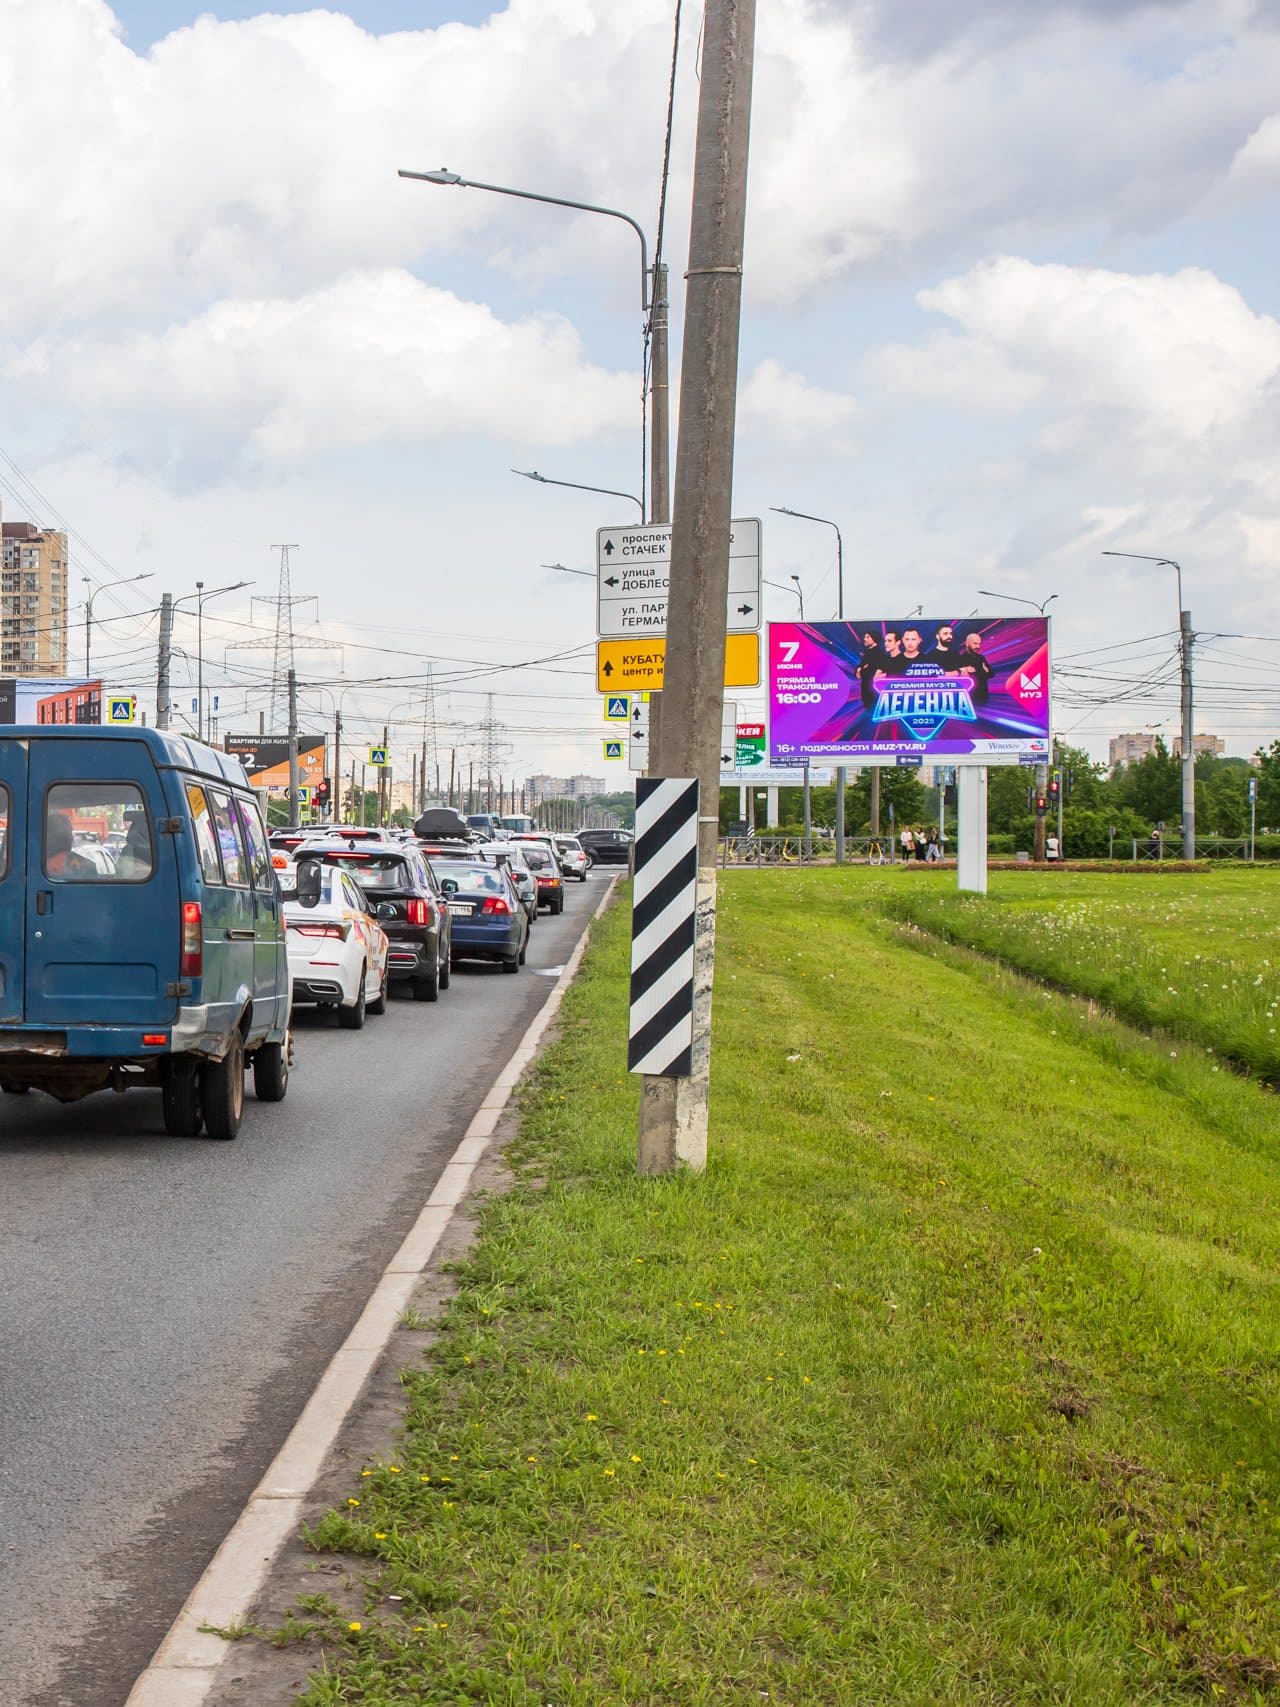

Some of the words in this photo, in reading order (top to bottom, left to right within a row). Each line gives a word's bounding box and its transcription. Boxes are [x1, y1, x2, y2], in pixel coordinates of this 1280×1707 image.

[622, 533, 672, 544] проспект
[622, 544, 666, 556] СТАЧЕК
[622, 569, 656, 579] улица
[622, 607, 638, 616] ул.
[779, 642, 800, 662] 7
[622, 667, 654, 677] центр
[905, 668, 944, 676] ЗВЕРИ
[776, 676, 815, 684] ПРЯМАЯ
[776, 683, 839, 691] ТРАНСЛЯЦИЯ
[776, 692, 822, 704] 16:00
[877, 691, 972, 717] ЛЕГЕНДА
[776, 743, 797, 753] 16+
[800, 744, 870, 752] ПОДРОБНОСТИ
[872, 743, 927, 751] MUZ-TV.RU
